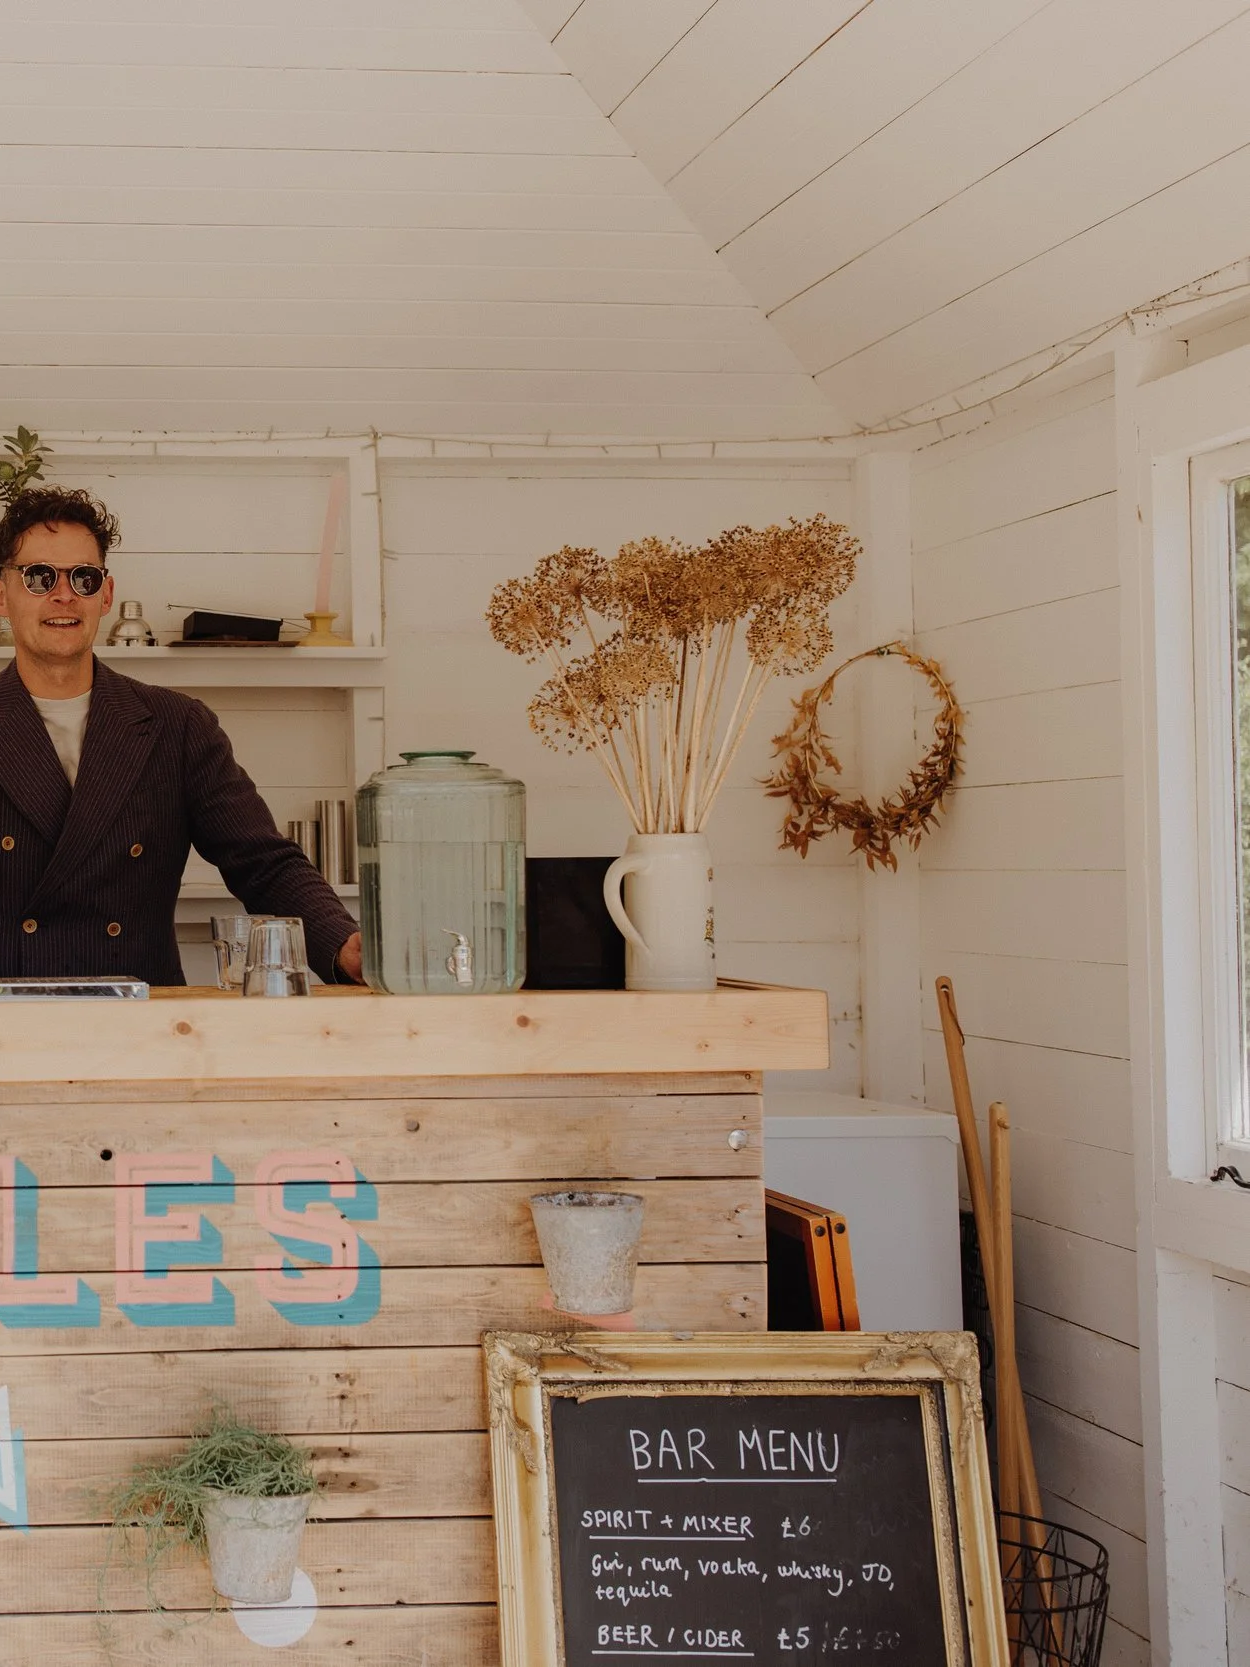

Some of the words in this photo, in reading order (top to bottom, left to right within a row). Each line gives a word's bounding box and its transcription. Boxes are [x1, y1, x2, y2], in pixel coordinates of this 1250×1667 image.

[630, 1429, 716, 1472] BAR
[739, 1429, 840, 1474] MENU
[581, 1510, 654, 1531] SPIRIT
[661, 1515, 674, 1530] +
[683, 1516, 754, 1538] MIXER
[780, 1516, 812, 1540] £6
[642, 1557, 689, 1582] rum,
[778, 1560, 855, 1598] whisky,
[863, 1563, 896, 1592] JD,
[595, 1580, 674, 1608] tequila
[598, 1625, 660, 1649] BEER
[684, 1629, 746, 1649] CIDER
[777, 1626, 811, 1651] £5
